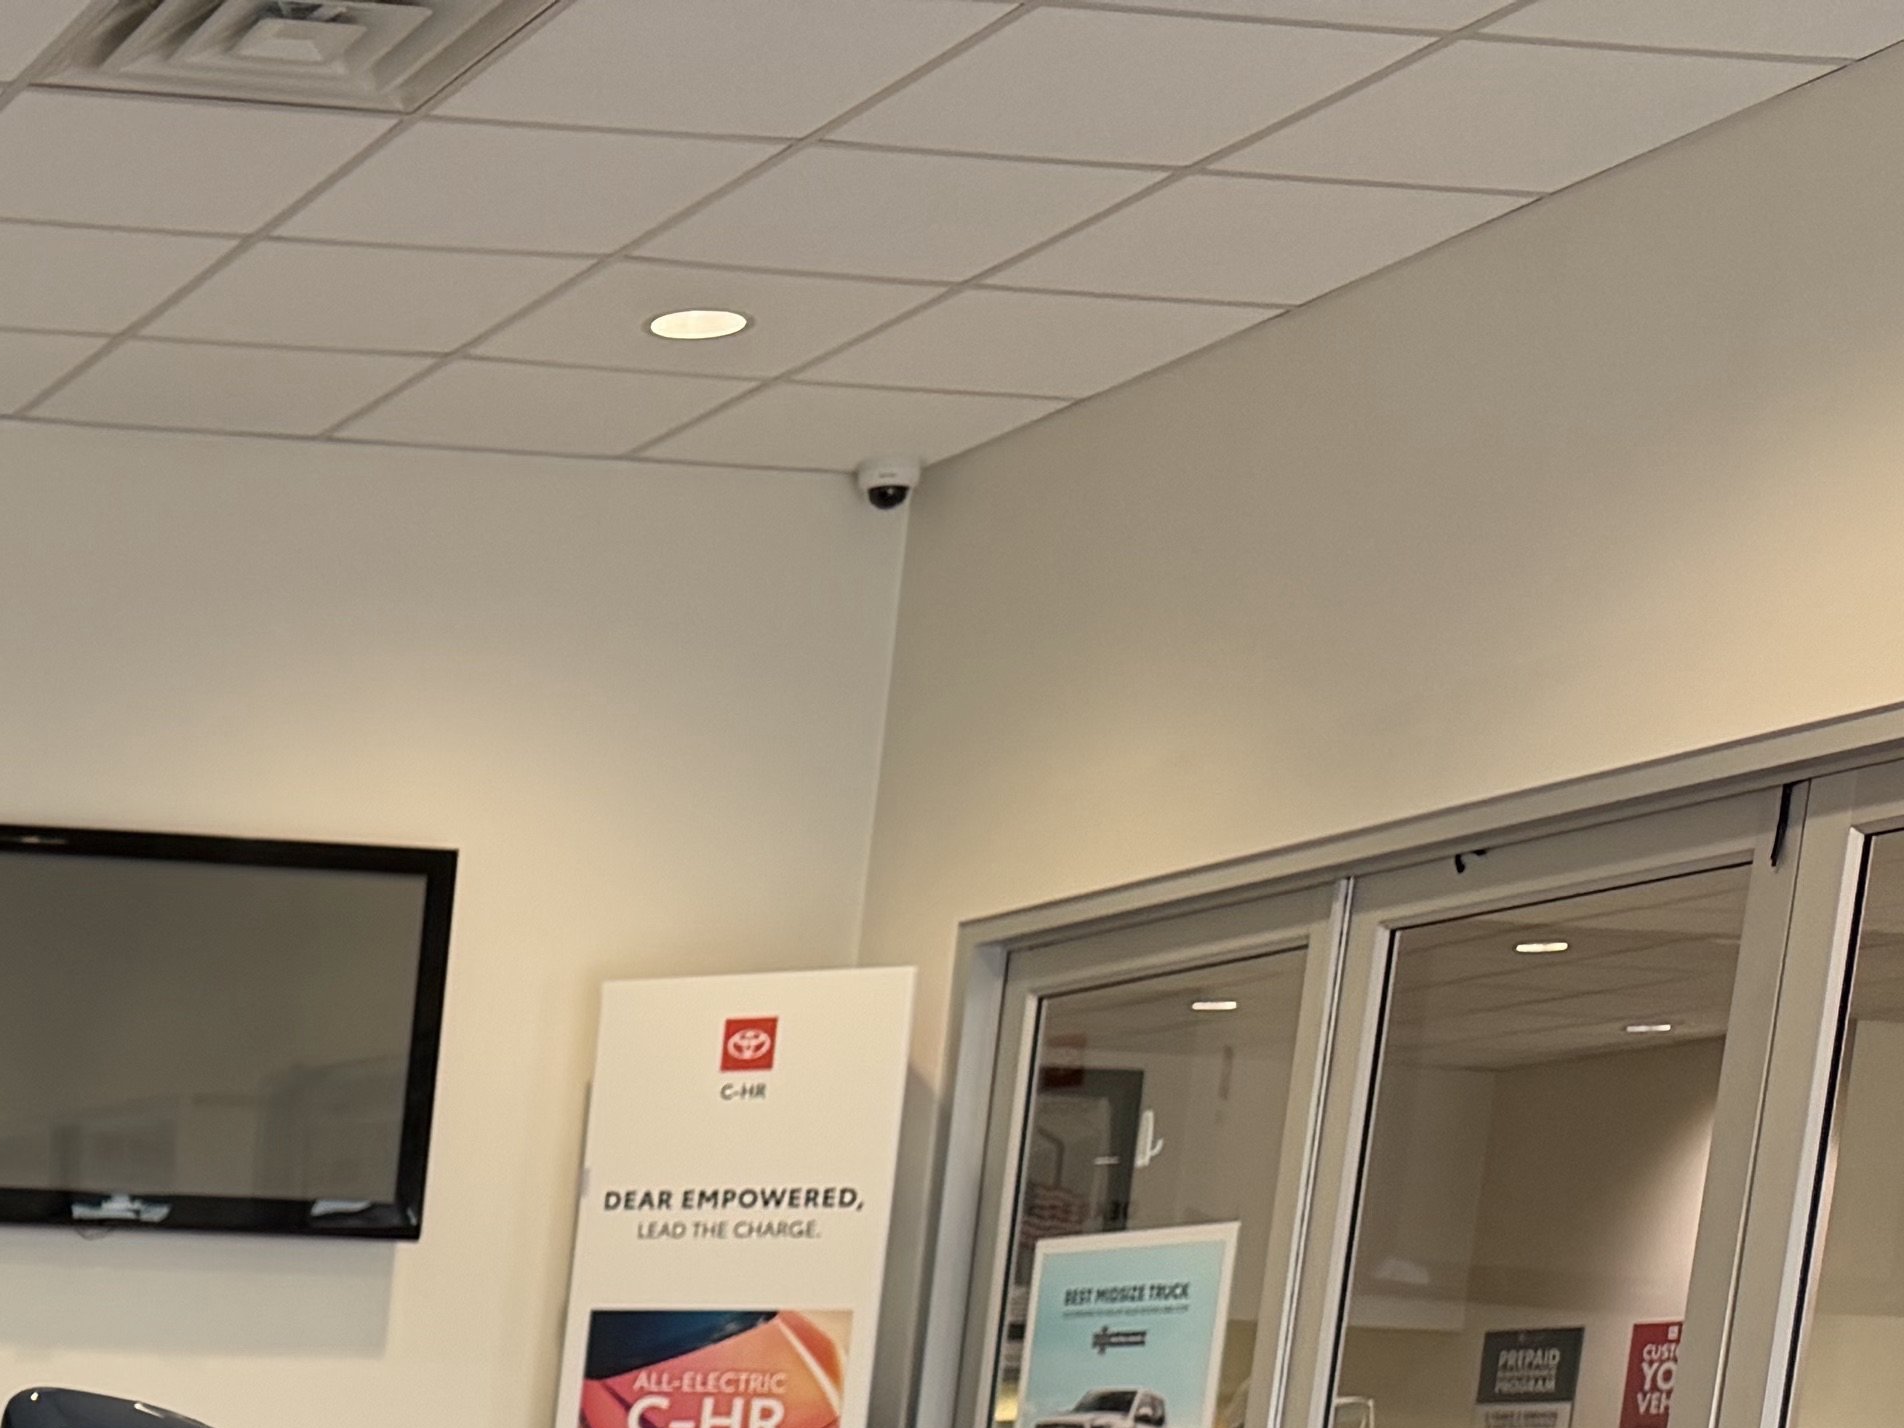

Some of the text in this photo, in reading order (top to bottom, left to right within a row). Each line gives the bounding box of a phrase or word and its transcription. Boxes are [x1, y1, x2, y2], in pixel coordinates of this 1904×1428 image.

[720, 1083, 766, 1101] C-HR
[604, 1188, 864, 1212] DEAR EMPOWERED,
[637, 1220, 821, 1239] LEAD THE CHARGE.
[1643, 1343, 1678, 1360] CUST
[633, 1372, 788, 1395] ALL-ELECTRIC
